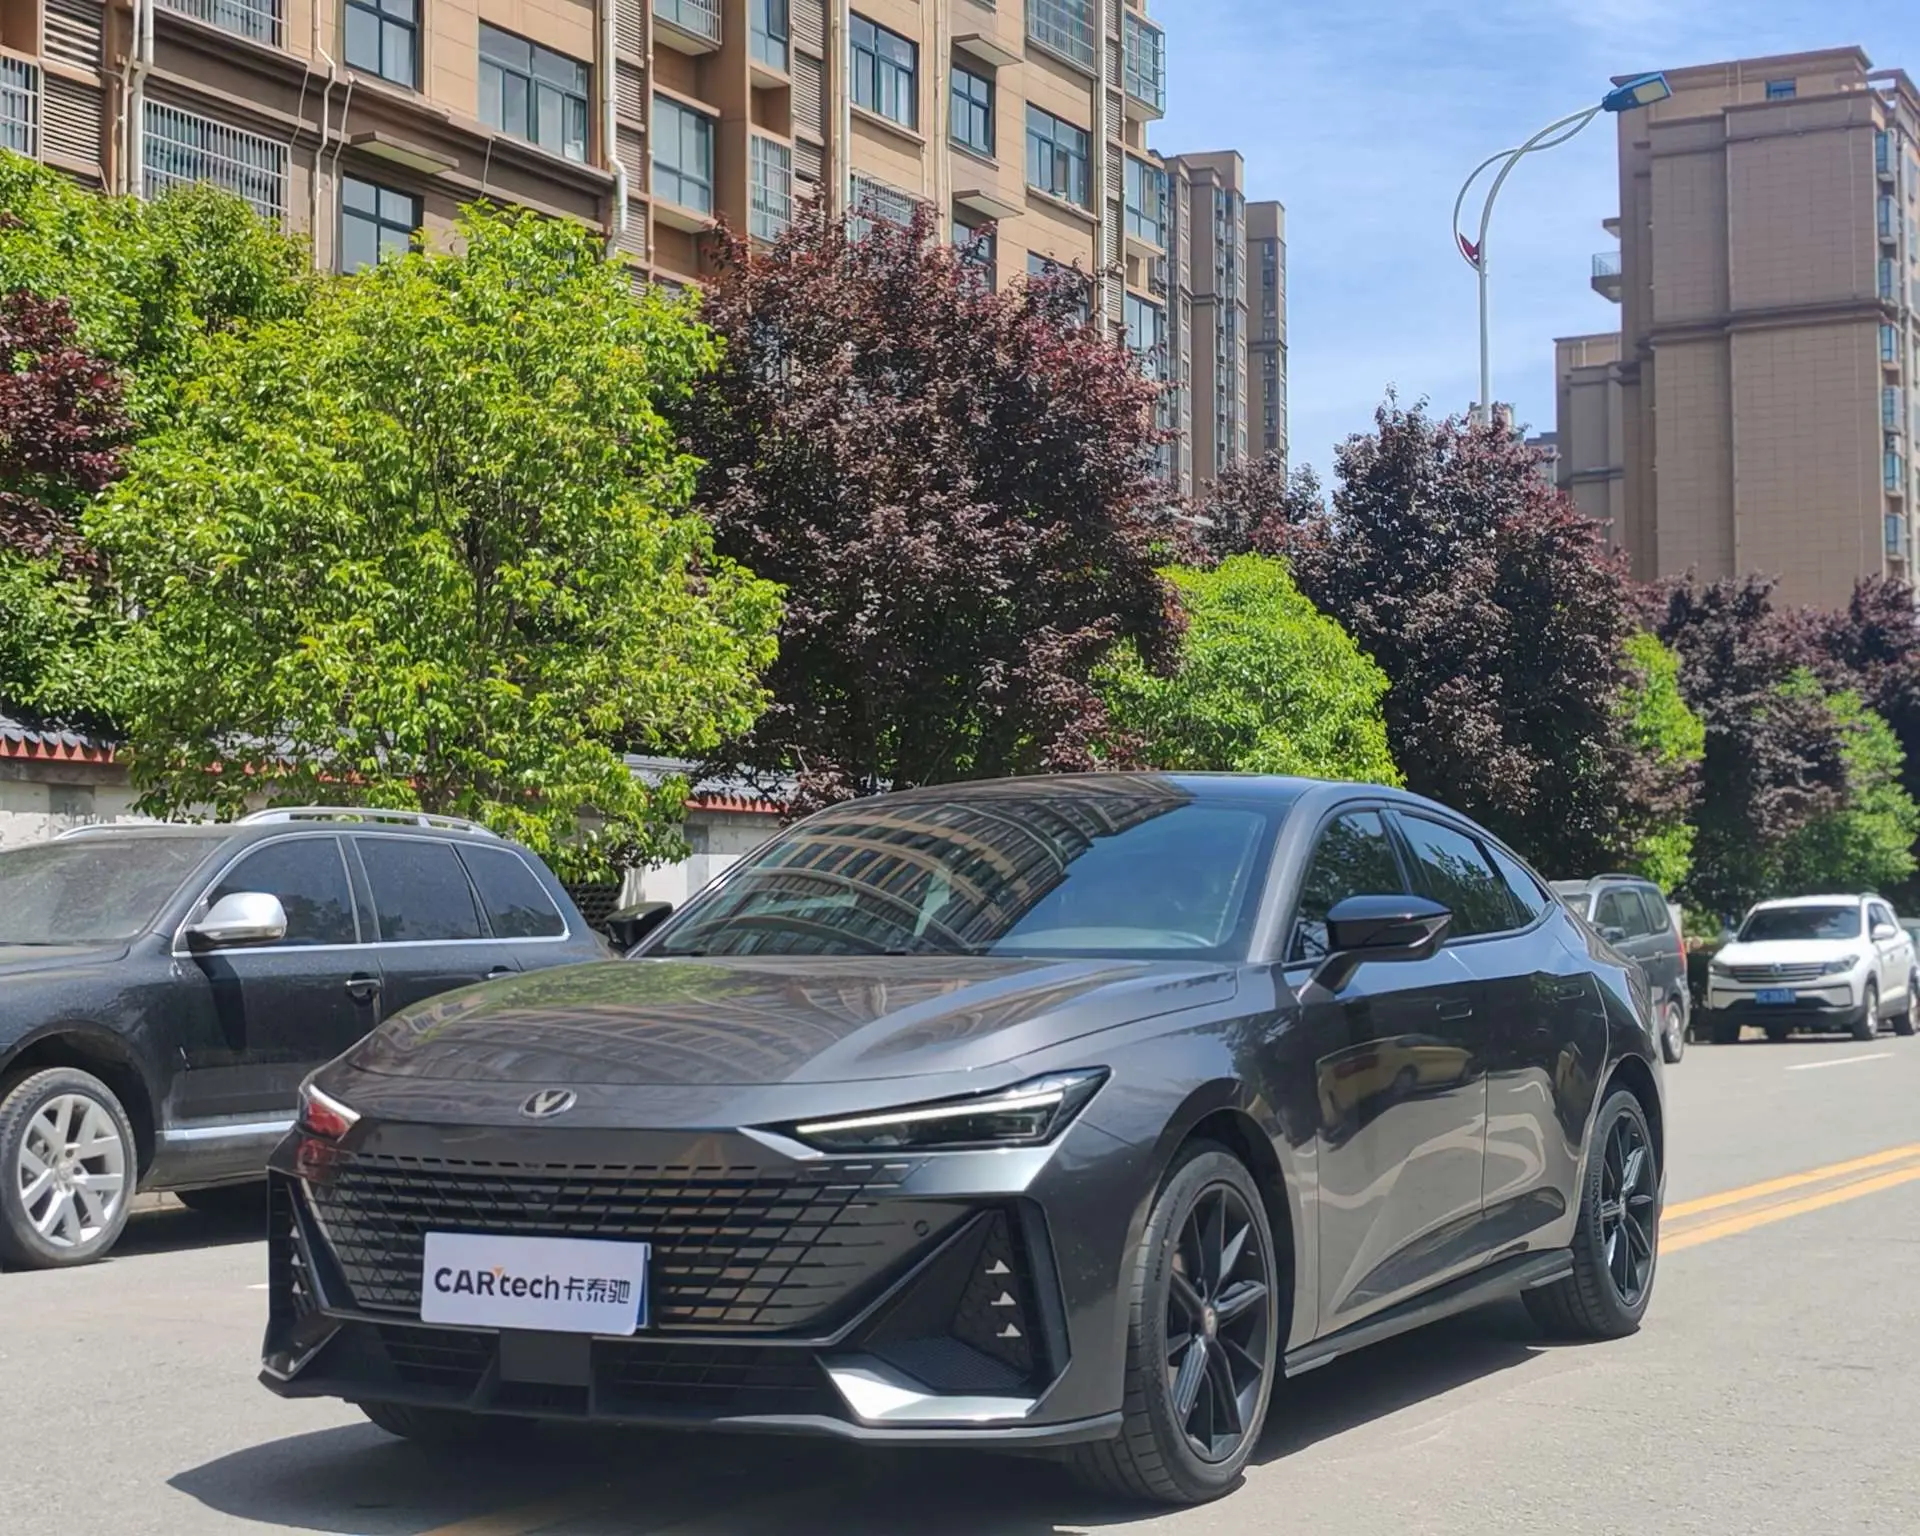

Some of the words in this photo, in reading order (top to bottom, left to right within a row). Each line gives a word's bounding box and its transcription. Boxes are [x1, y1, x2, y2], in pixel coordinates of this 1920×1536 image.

[434, 1266, 559, 1301] CARtech
[563, 1275, 631, 1304] 卡泰驰
